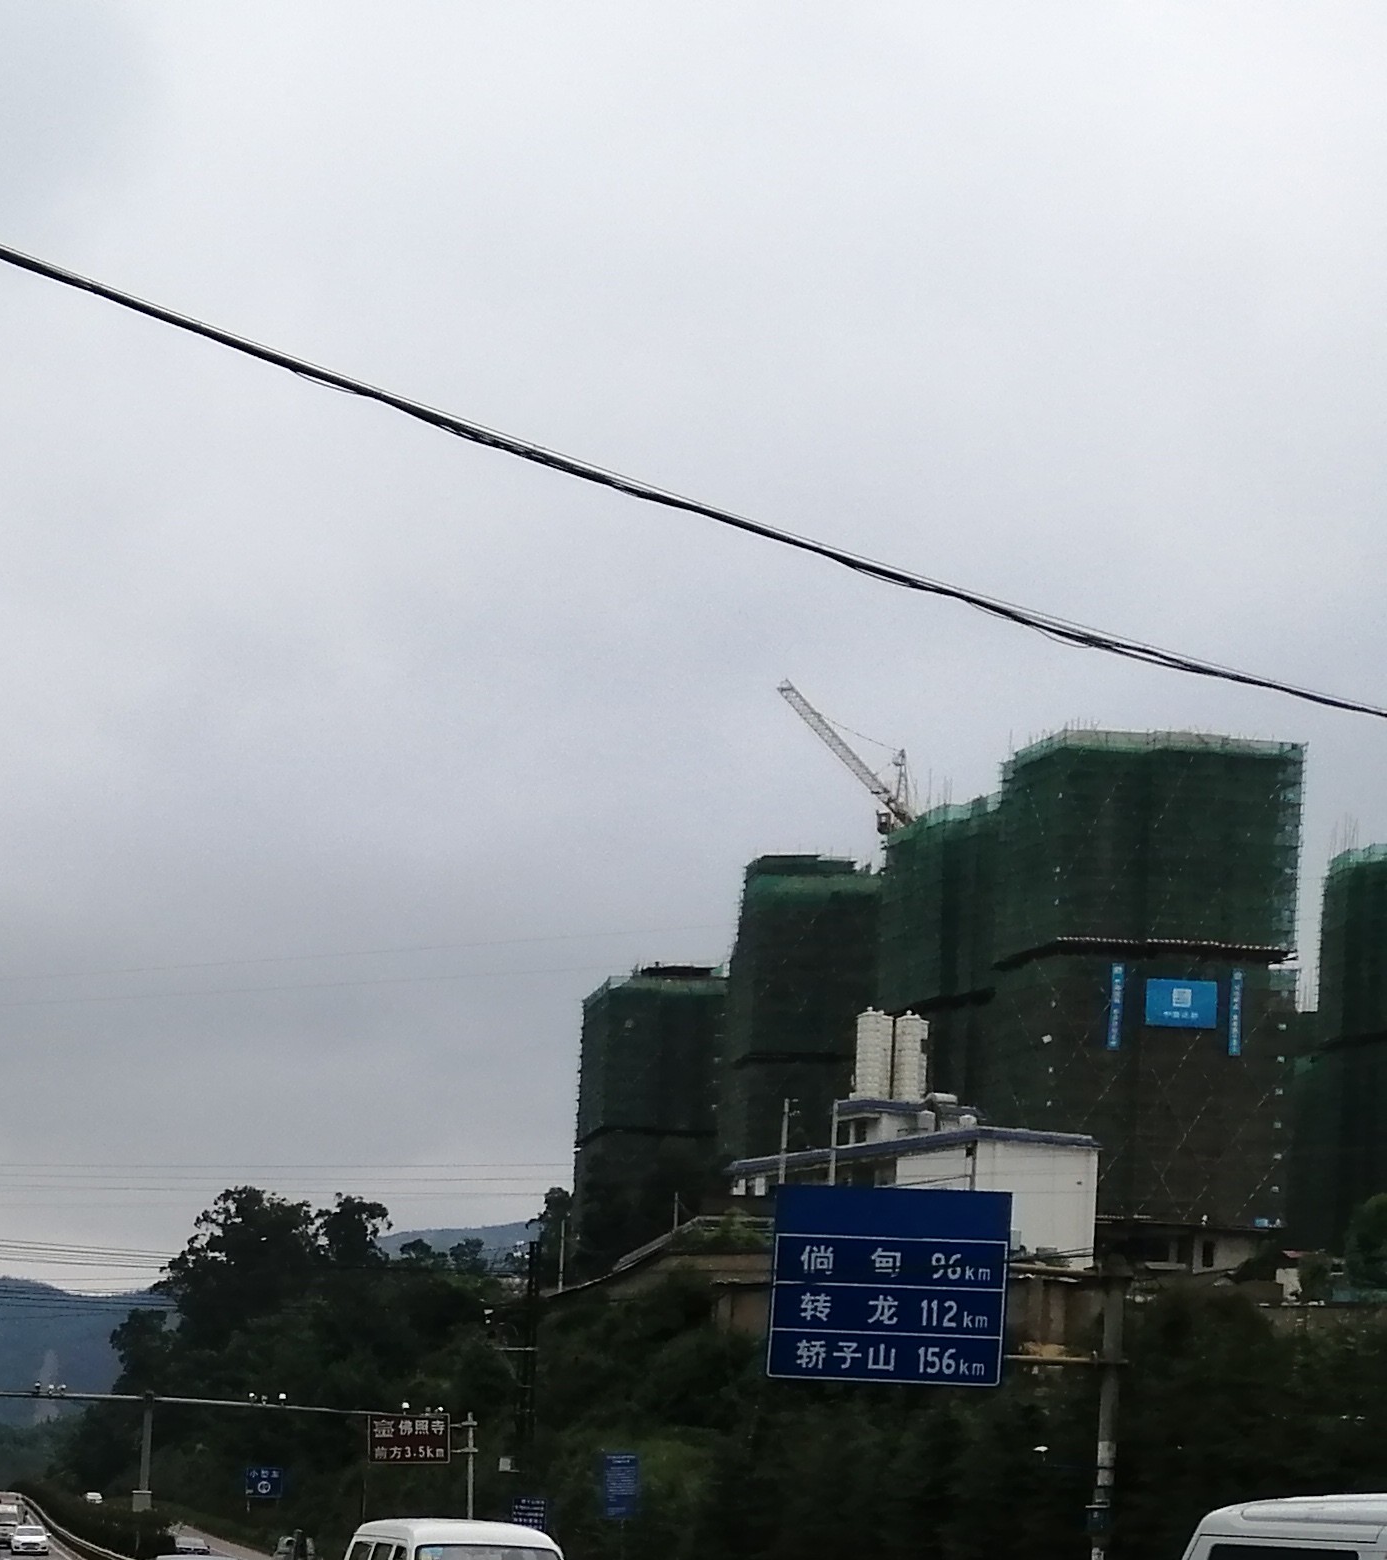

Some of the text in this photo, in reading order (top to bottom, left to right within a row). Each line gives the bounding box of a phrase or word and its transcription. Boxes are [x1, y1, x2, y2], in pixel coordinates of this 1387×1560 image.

[800, 1292, 898, 1326] 转龙
[796, 1339, 896, 1372] 轿子山
[399, 1419, 446, 1435] 佛照寺
